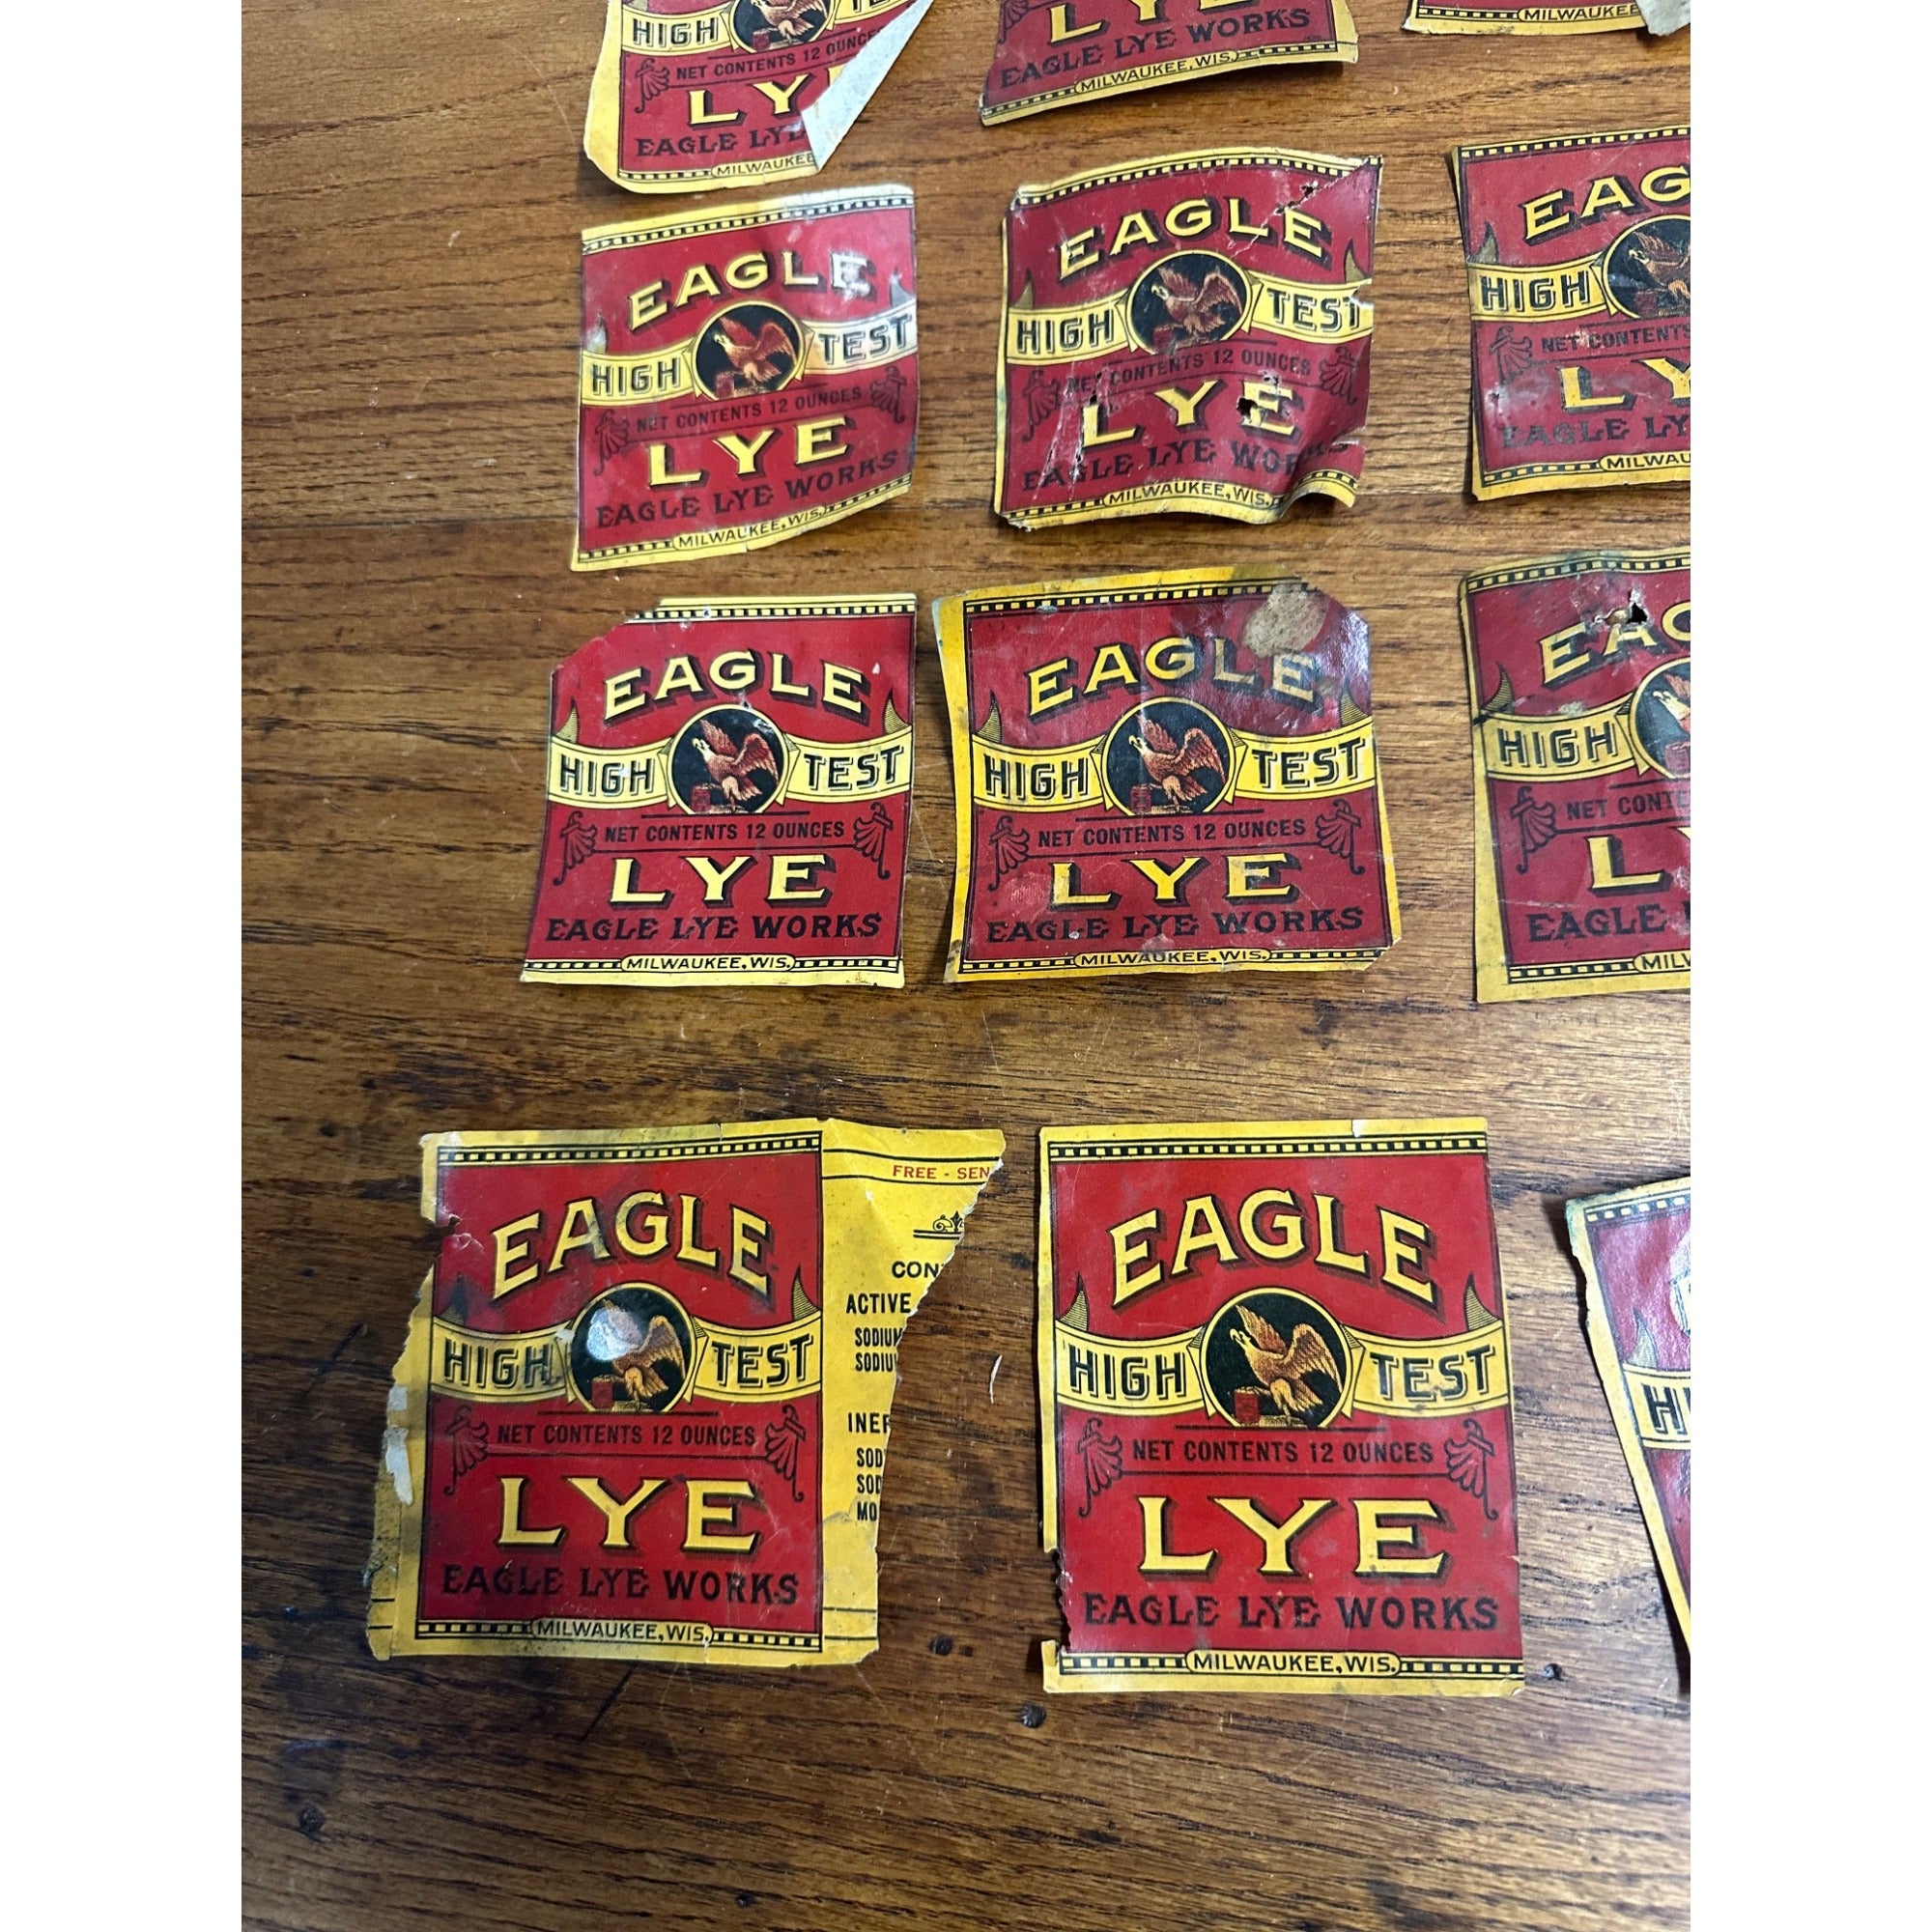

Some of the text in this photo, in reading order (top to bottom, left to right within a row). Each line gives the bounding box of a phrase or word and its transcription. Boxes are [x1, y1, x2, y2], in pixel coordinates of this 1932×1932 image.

[633, 16, 719, 45] HIGH
[1000, 45, 1104, 89] EAGLE
[1115, 28, 1177, 59] LYE
[1187, 8, 1311, 44] WORKS
[676, 65, 707, 81] NET
[714, 54, 796, 77] CONTENTS
[802, 47, 821, 63] 12
[688, 66, 844, 129] LY
[636, 132, 736, 156] EAGLE
[1059, 196, 1332, 282] EAGLE
[629, 248, 877, 333] EAGLE
[1480, 270, 1590, 312] HIGH
[1016, 308, 1115, 355] HIGH
[1542, 334, 1578, 354] NET
[591, 314, 913, 398] HIGH TEST
[1110, 354, 1203, 385] CONTENTS
[1212, 349, 1235, 365] 12
[1240, 350, 1311, 376] OUNCES
[637, 386, 863, 433] NET CONTENTS 12 OUNCES
[1081, 380, 1304, 450] LYE
[1501, 417, 1630, 449] EAGLE
[646, 415, 857, 491] LYE
[1022, 452, 1135, 492] EAGLE
[1147, 438, 1217, 476] LYE
[597, 448, 898, 529] EAGLE LYE WORKS
[603, 648, 870, 725] EAGLE
[1026, 634, 1324, 724] EAGLE
[1496, 720, 1618, 767] HIGH
[560, 745, 904, 794] HIGH TEST
[983, 737, 1366, 801] HIGH TEST
[604, 820, 845, 843] NET CONTENTS 12 OUNCES
[1037, 818, 1306, 848] NET CONTENTS 12 OUNCES
[1567, 800, 1607, 820] NET
[610, 854, 836, 911] LYE
[1049, 852, 1301, 913] LYE
[545, 912, 882, 942] EAGLE LYE WORKS
[986, 906, 1364, 944] EAGLE LYE WORKS
[1526, 903, 1668, 943] EAGLE
[893, 1164, 937, 1179] FREE
[491, 1189, 773, 1306] EAGLE
[892, 1261, 945, 1278] CON
[1108, 1187, 1442, 1320] EAGLE
[846, 1293, 911, 1315] ACTIVE
[443, 1331, 813, 1389] HIGH TEST
[855, 1352, 897, 1372] SODIU
[1068, 1344, 1493, 1402] HIGH TEST
[497, 1424, 756, 1447] NET CONTENTS 12 OUNCES
[857, 1447, 887, 1467] SOD
[1132, 1439, 1434, 1463] NET CONTENTS 12 OUNCES
[495, 1474, 763, 1554] LYE
[857, 1501, 877, 1521] MO
[1137, 1494, 1452, 1581] LYE
[442, 1565, 800, 1605] EAGLE LYE WORKS
[1085, 1594, 1499, 1632] EAGLE LYE WORKS
